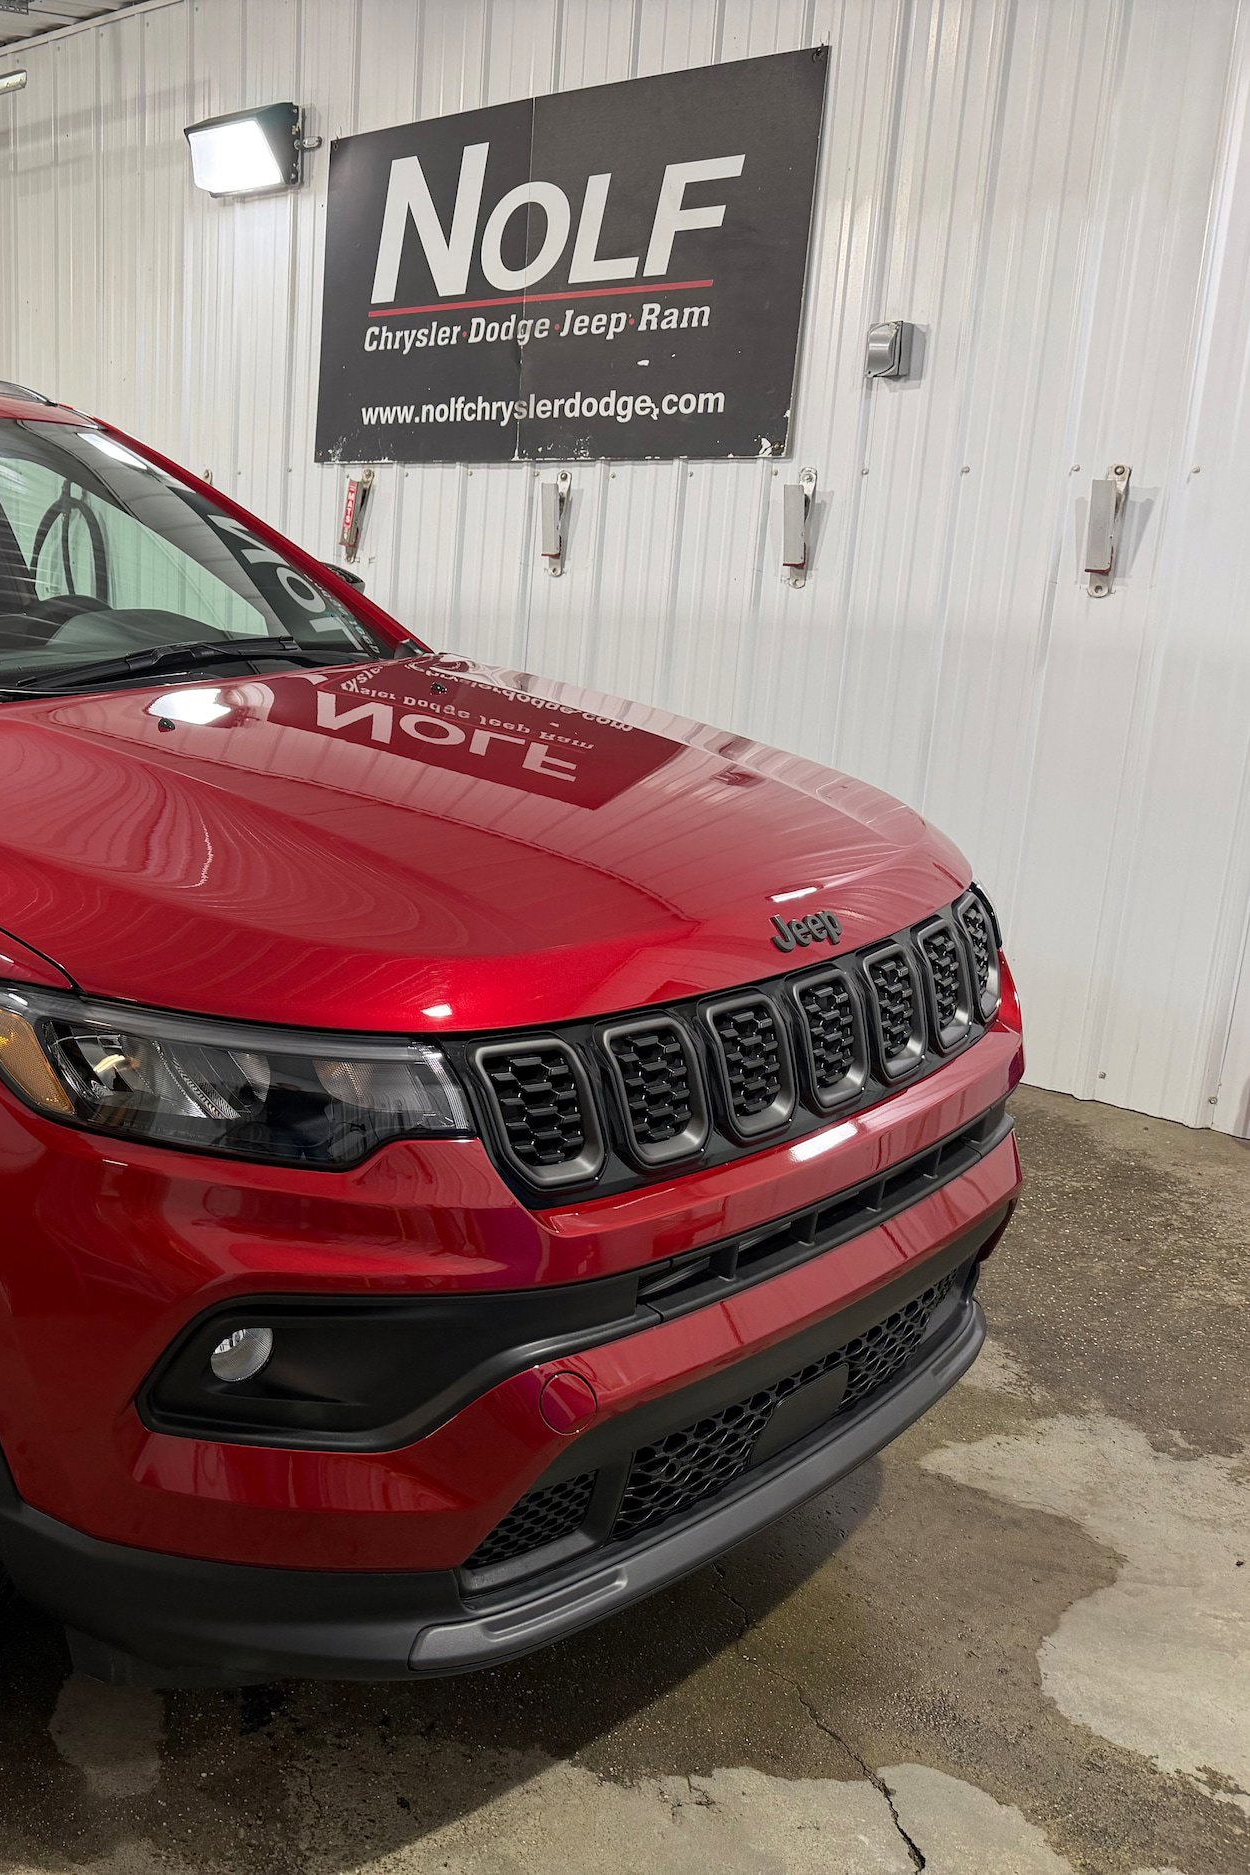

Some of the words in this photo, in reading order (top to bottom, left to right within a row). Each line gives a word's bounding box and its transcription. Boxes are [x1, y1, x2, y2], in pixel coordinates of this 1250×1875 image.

[371, 142, 746, 304] NOLF
[363, 321, 461, 355] Chrysler
[468, 315, 550, 346] Dodge
[559, 308, 628, 340] Jeep
[638, 302, 711, 332] Ram
[361, 390, 726, 427] www.nolfchryslerdodge.com
[769, 911, 843, 952] Jeep
